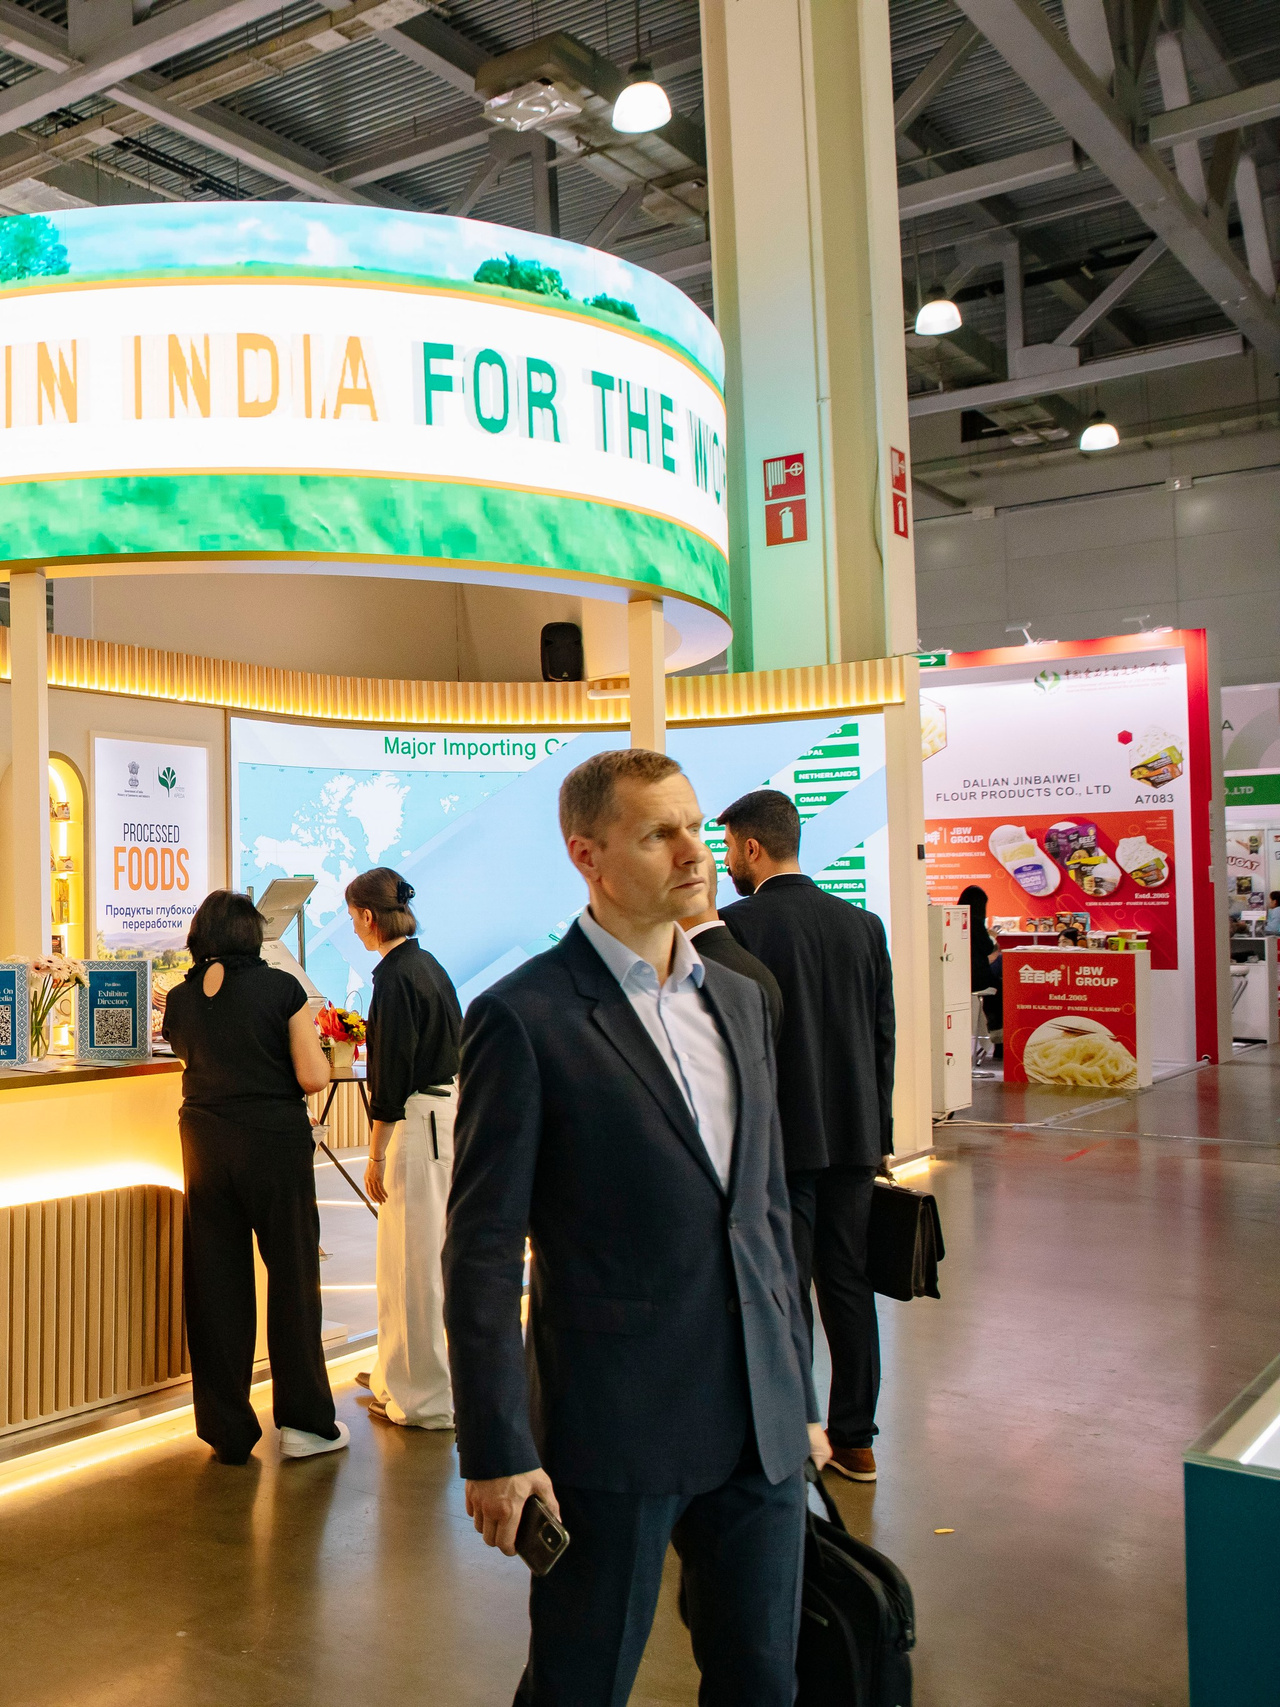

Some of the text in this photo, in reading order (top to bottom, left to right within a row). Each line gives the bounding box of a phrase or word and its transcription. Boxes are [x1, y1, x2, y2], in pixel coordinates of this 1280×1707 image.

[5, 338, 79, 428] IN
[135, 332, 380, 421] INDIA
[422, 341, 565, 444] FOR
[591, 370, 676, 474] THE
[384, 736, 436, 760] Major
[443, 737, 536, 760] Importing
[799, 770, 858, 780] NETHERLANDS
[963, 773, 1081, 789] DALIAN JINBAIWEI
[799, 795, 827, 803] OMAN
[936, 790, 978, 802] FLOUR
[981, 787, 1051, 801] PRODUCTS
[1086, 784, 1111, 796] LTD
[1135, 793, 1174, 805] A7083
[123, 822, 180, 844] PROCESSED
[950, 827, 972, 836] JBW
[950, 835, 984, 844] GROUP
[113, 846, 190, 892] FOODS
[1227, 855, 1260, 871] UGAT
[832, 882, 864, 890] AFRICA
[105, 903, 197, 919] Продукты глубокой
[122, 918, 183, 932] переработки
[1075, 966, 1103, 976] JBW
[1075, 977, 1119, 987] GROUP
[3, 987, 14, 995] On
[97, 998, 129, 1006] Directory
